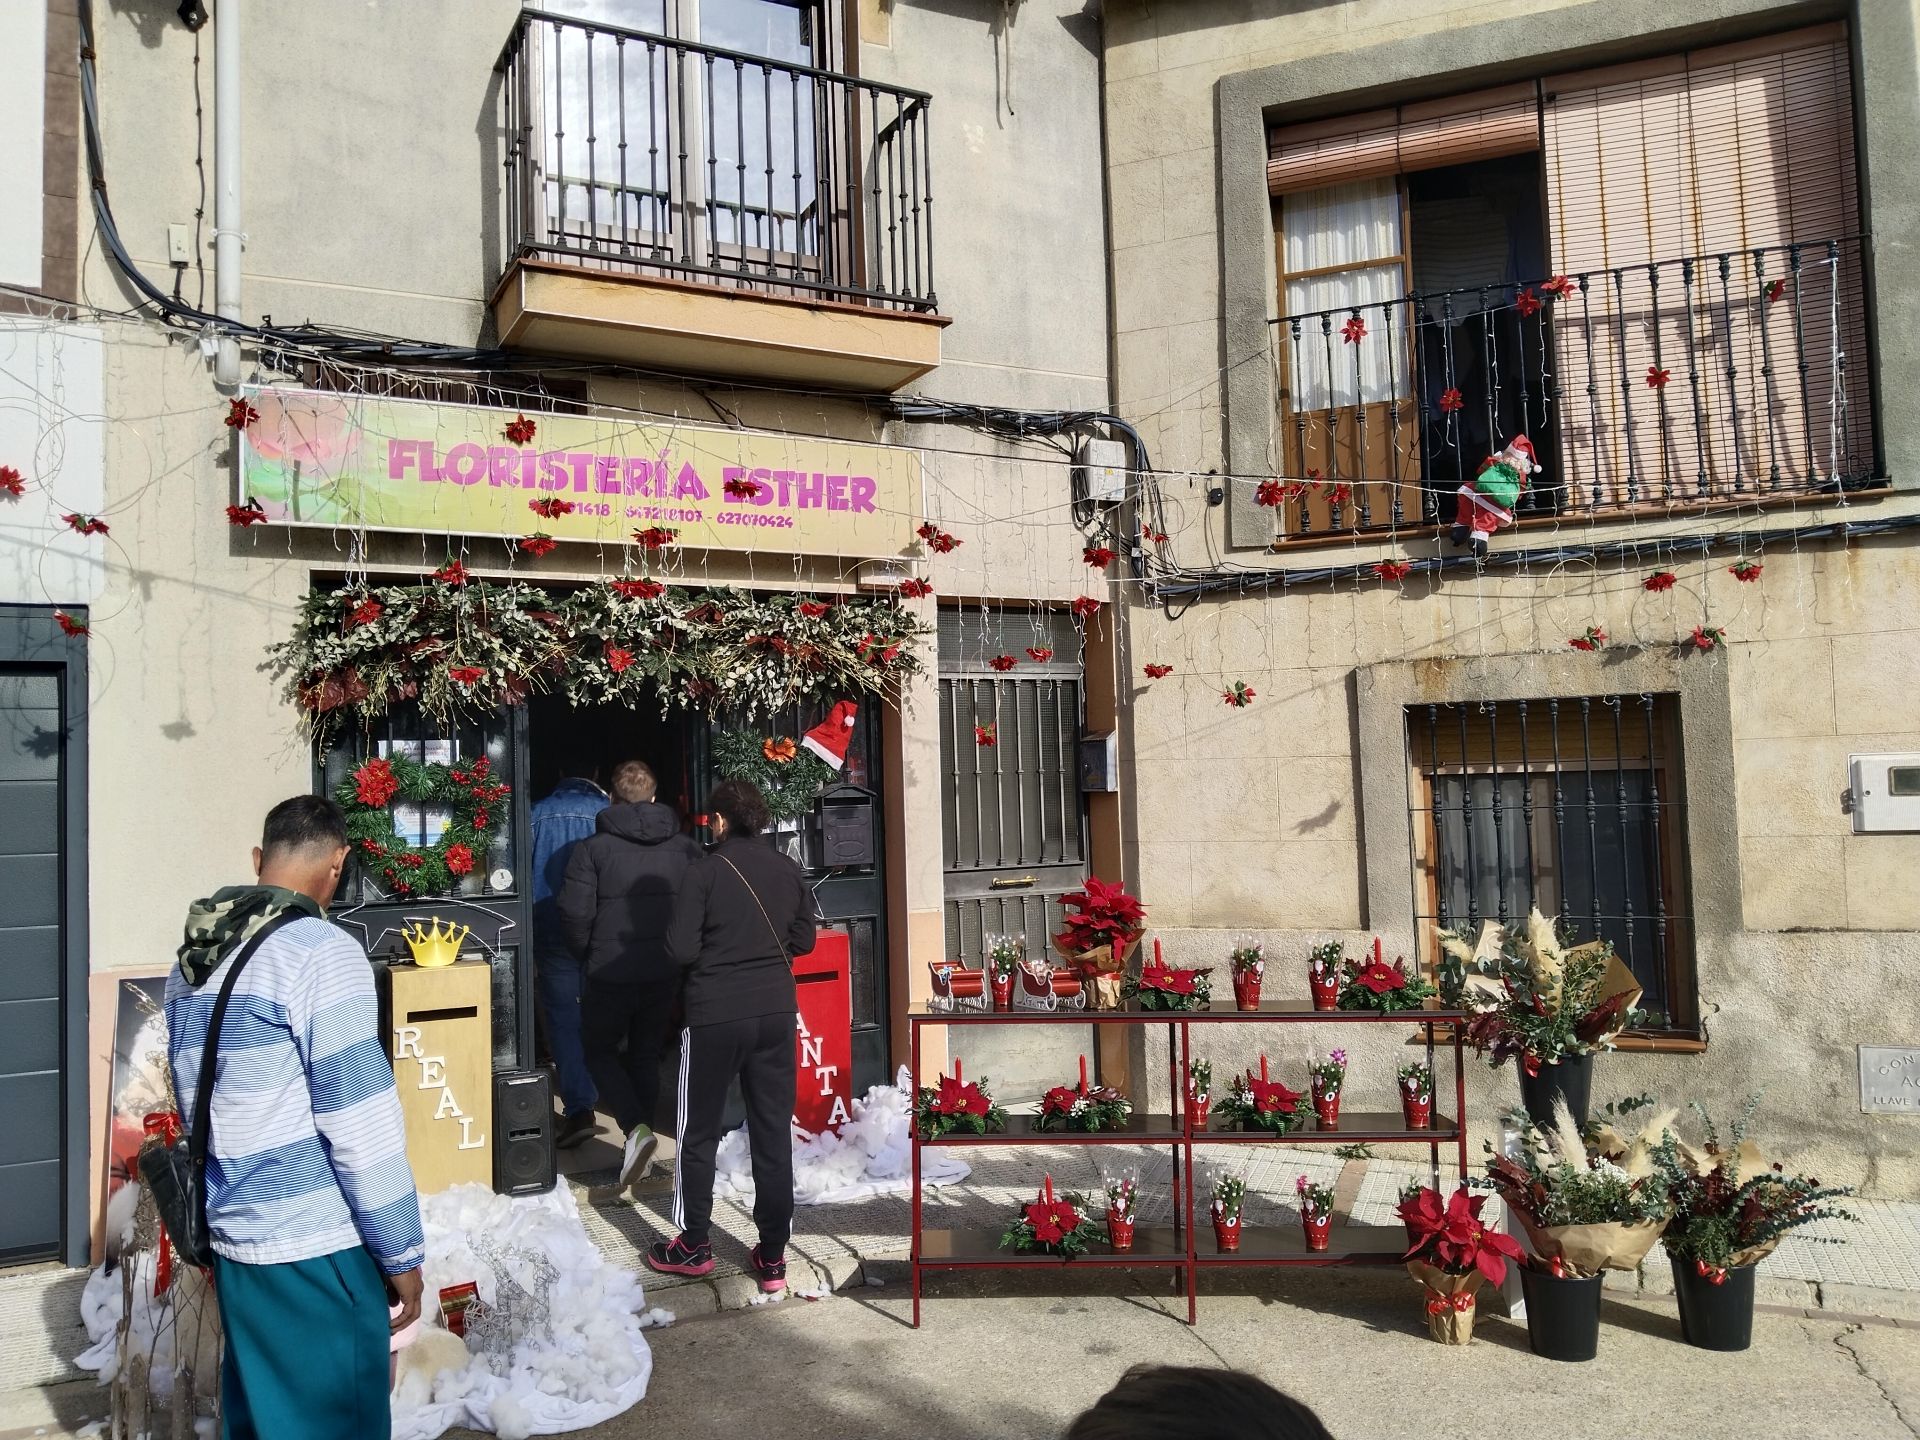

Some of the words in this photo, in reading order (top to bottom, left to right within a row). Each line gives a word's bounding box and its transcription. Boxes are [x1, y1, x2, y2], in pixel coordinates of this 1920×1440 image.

[387, 438, 712, 502] FLORISTERÍA
[722, 466, 878, 515] ESTHER
[716, 513, 795, 529] 627070424
[394, 1026, 485, 1150] REAL
[796, 1012, 851, 1125] ANTA
[1873, 1096, 1912, 1106] LLAVE
